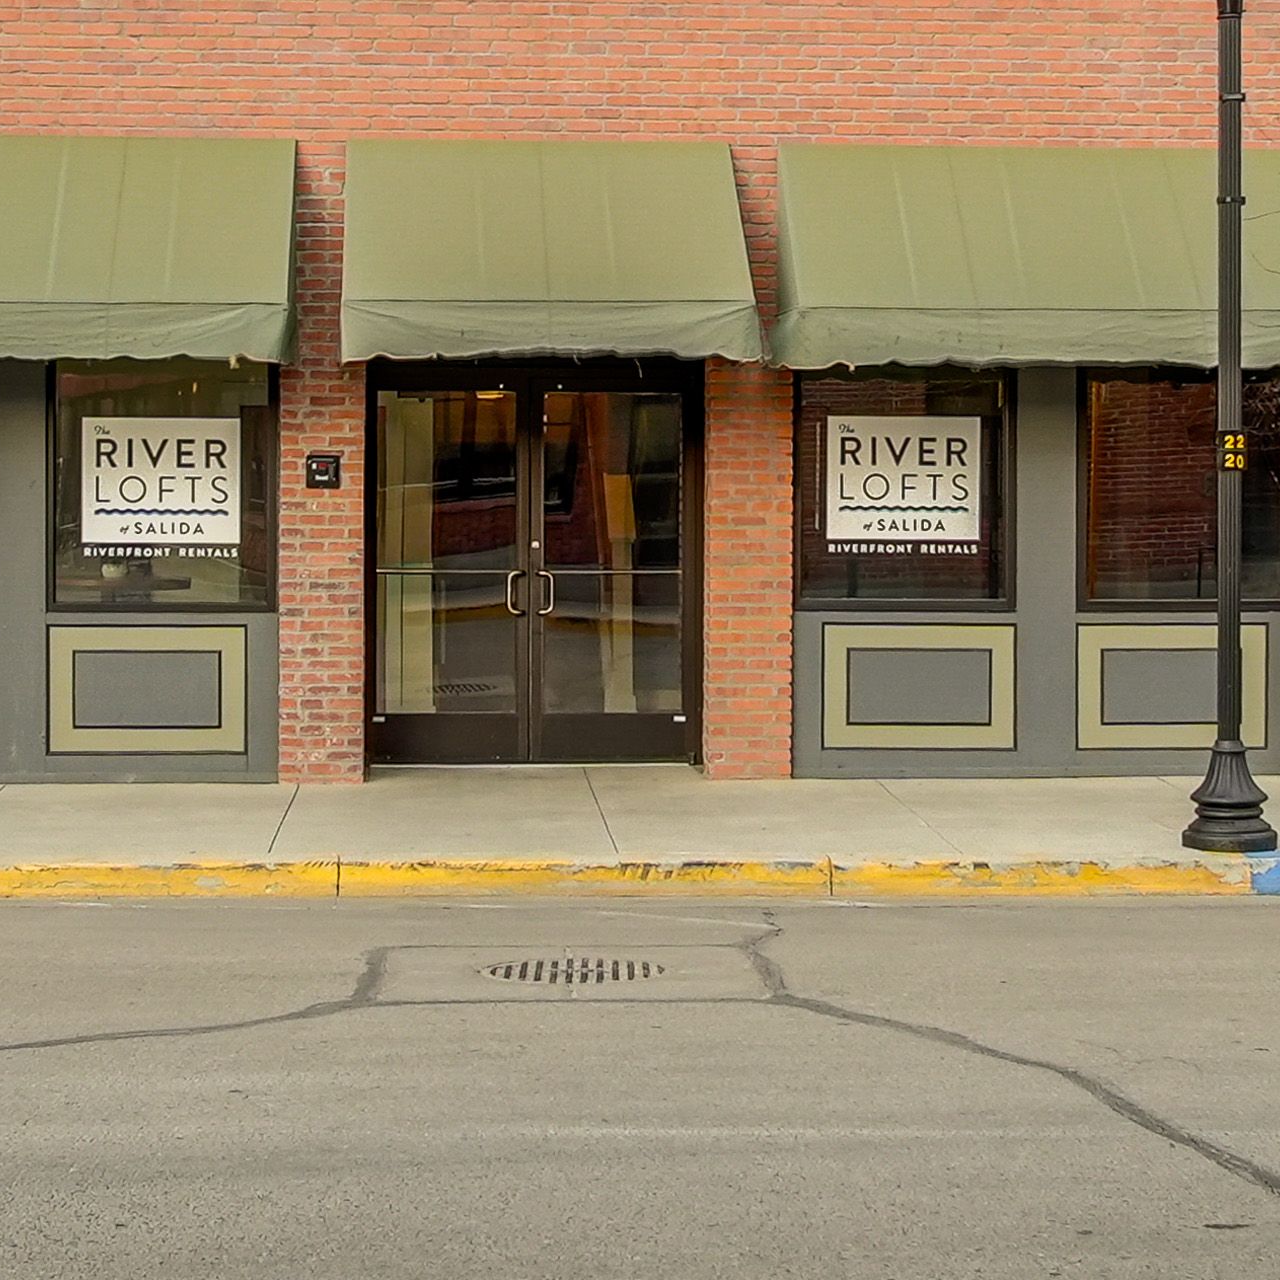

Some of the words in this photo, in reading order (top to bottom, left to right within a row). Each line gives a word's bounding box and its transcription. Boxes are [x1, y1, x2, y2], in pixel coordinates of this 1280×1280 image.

[1224, 434, 1245, 449] 22
[96, 438, 227, 468] RIVER
[840, 436, 968, 466] RIVER
[1224, 453, 1245, 469] 20
[95, 475, 229, 504] LOFTS
[840, 473, 969, 501] LOFTS
[134, 521, 205, 535] SALIDA
[877, 519, 946, 532] SALIDA
[83, 547, 171, 557] RIVERFRONT
[179, 547, 238, 558] RENTALS
[828, 543, 914, 554] RIVERFRONT
[920, 543, 979, 554] RENTALS
